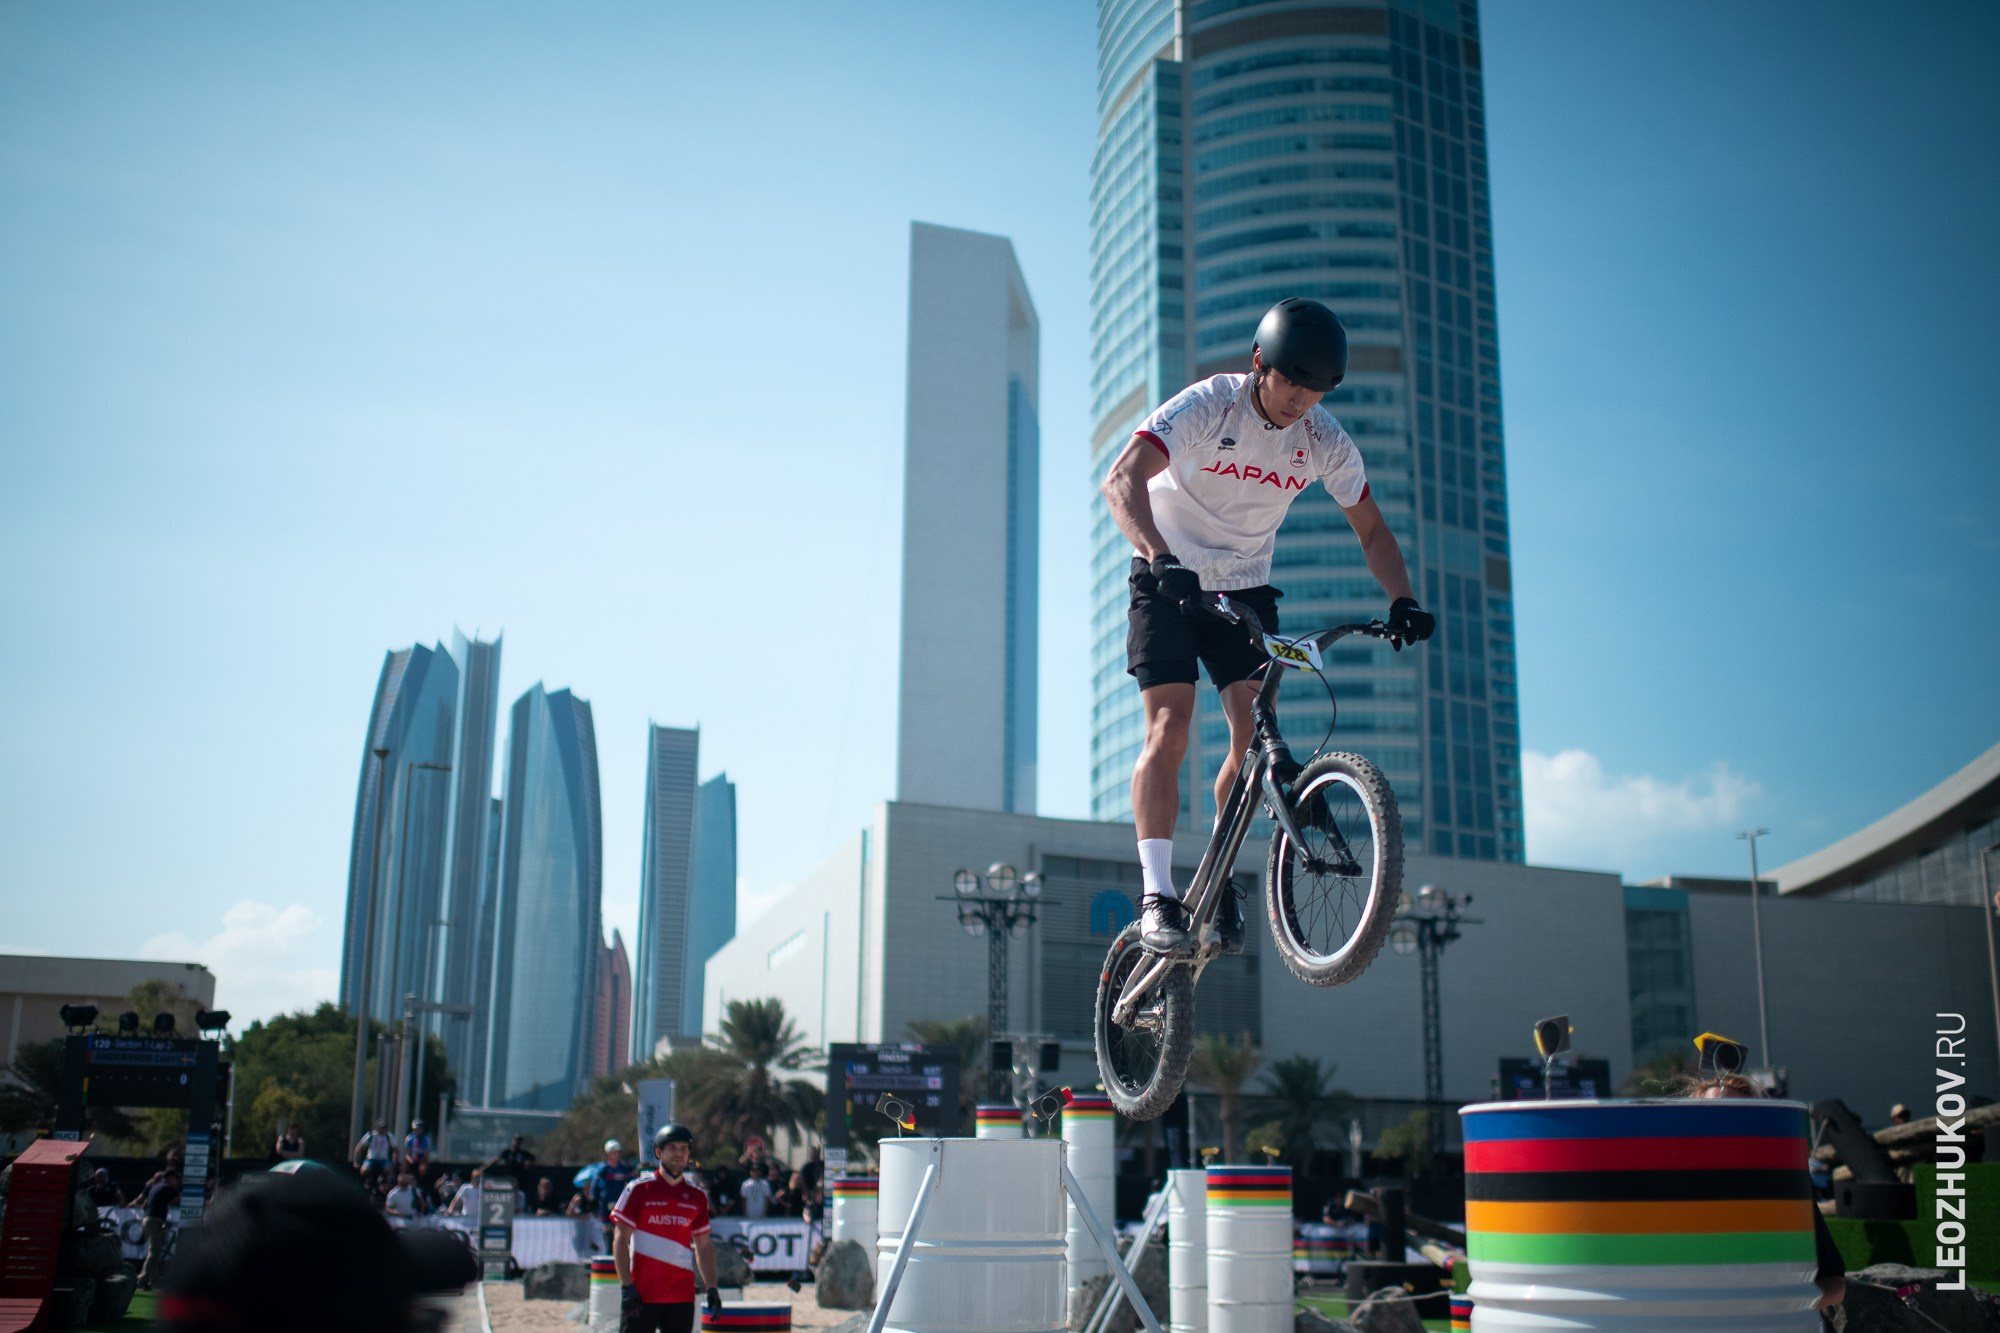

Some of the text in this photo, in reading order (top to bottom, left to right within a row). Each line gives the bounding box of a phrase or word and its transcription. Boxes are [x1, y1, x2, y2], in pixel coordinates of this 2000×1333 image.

[1200, 460, 1307, 490] JAPAN
[1272, 644, 1305, 662] 128
[94, 1039, 111, 1049] 120
[180, 1073, 188, 1086] 0
[490, 1204, 504, 1225] 2
